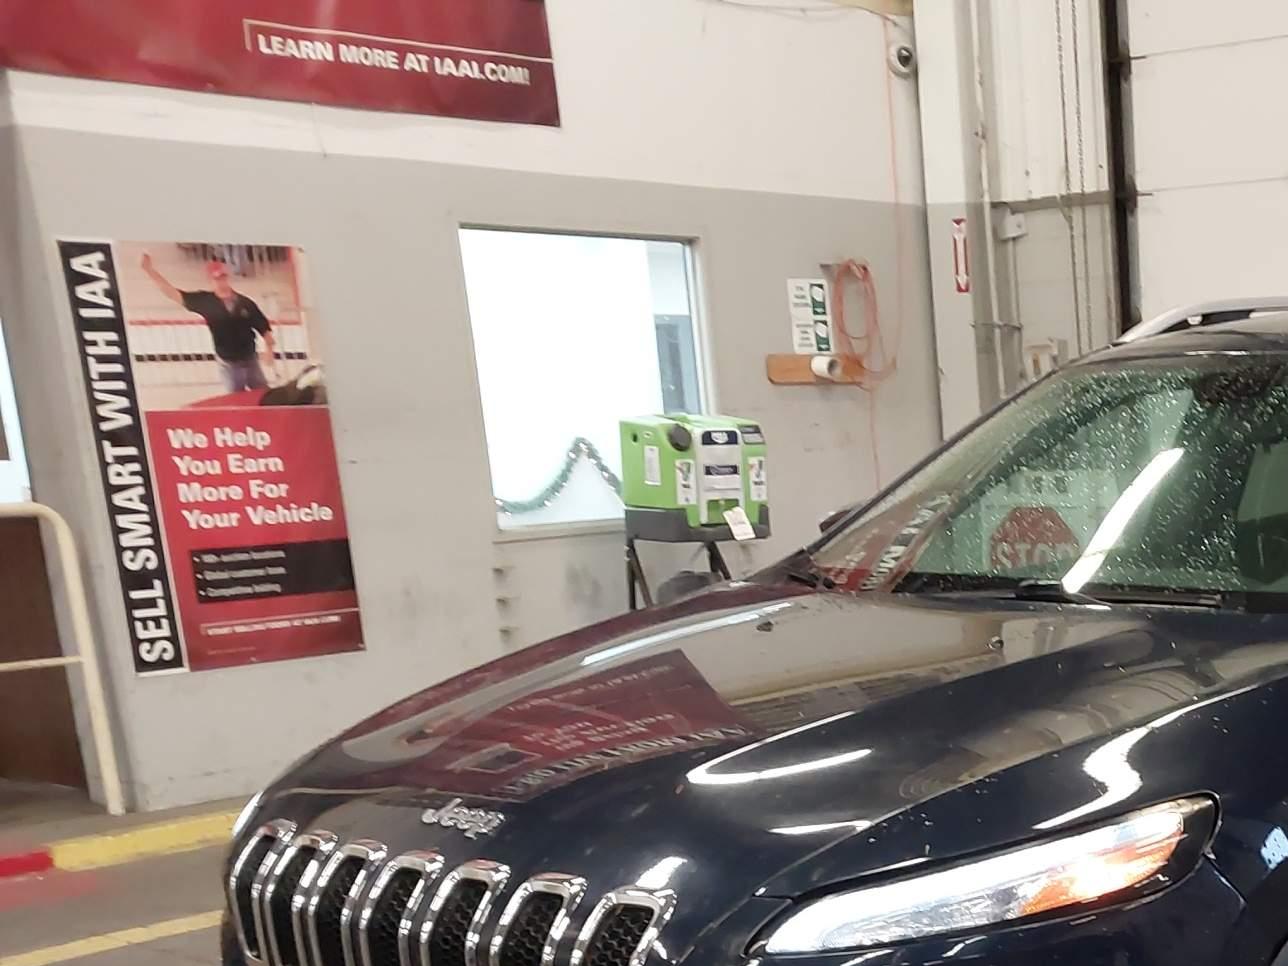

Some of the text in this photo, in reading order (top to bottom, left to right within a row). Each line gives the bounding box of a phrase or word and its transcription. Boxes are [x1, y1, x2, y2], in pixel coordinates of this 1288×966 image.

[257, 33, 334, 62] LEARN
[339, 43, 400, 70] MORE
[404, 52, 429, 73] AT
[166, 426, 272, 450] We Help
[70, 252, 175, 663] SELL SMART WITH IAA
[172, 453, 285, 476] You Earn
[177, 479, 289, 503] More For
[182, 502, 334, 530] Your Vehicle
[421, 797, 506, 840] Jeep
